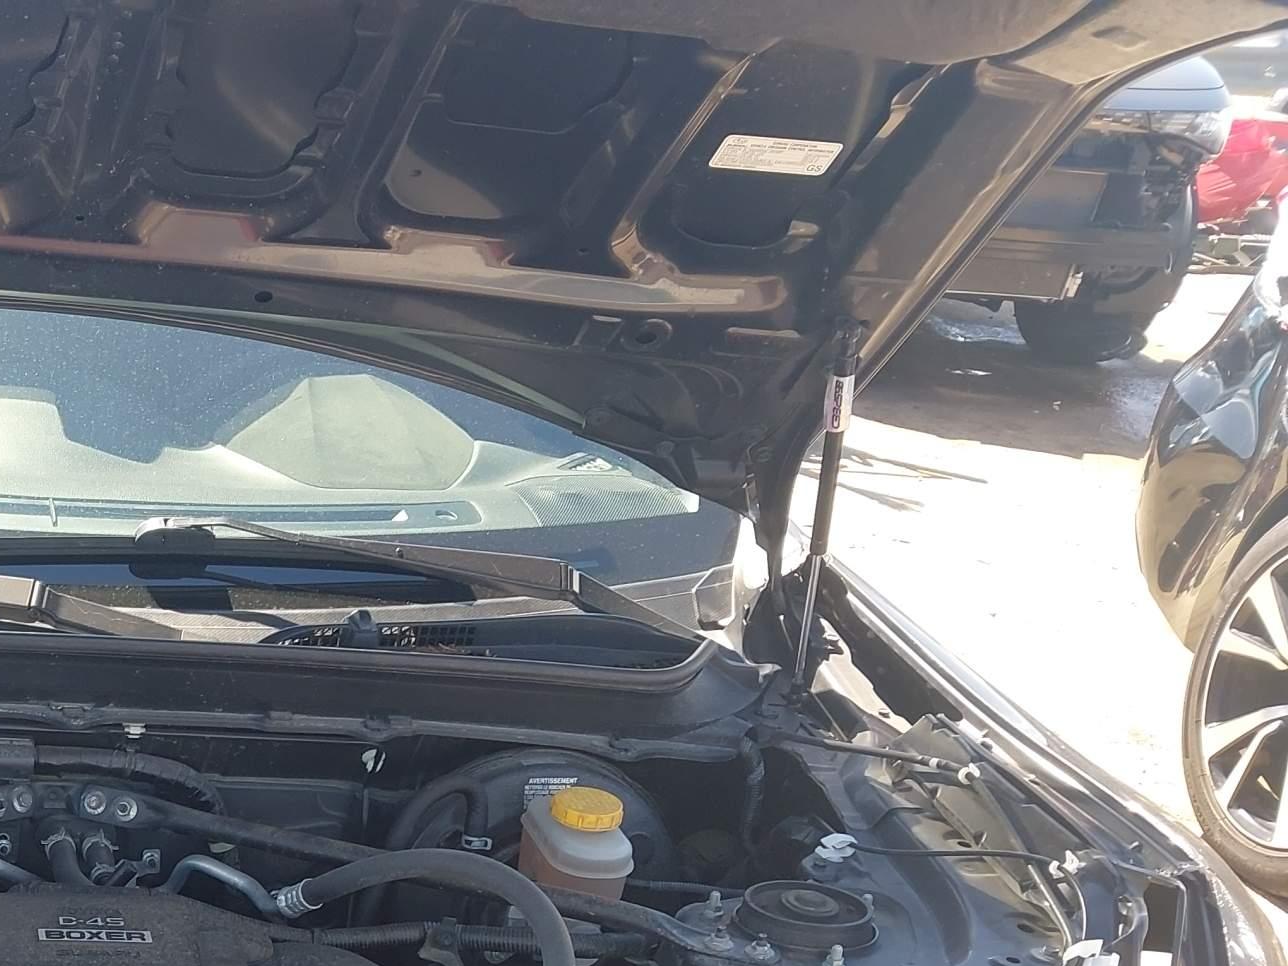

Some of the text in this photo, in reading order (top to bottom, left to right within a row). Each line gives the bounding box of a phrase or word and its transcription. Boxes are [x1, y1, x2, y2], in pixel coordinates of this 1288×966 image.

[806, 164, 823, 172] GS
[528, 777, 578, 785] AVERTISSEMENT
[58, 916, 125, 926] D-4S
[44, 930, 147, 941] BOXER
